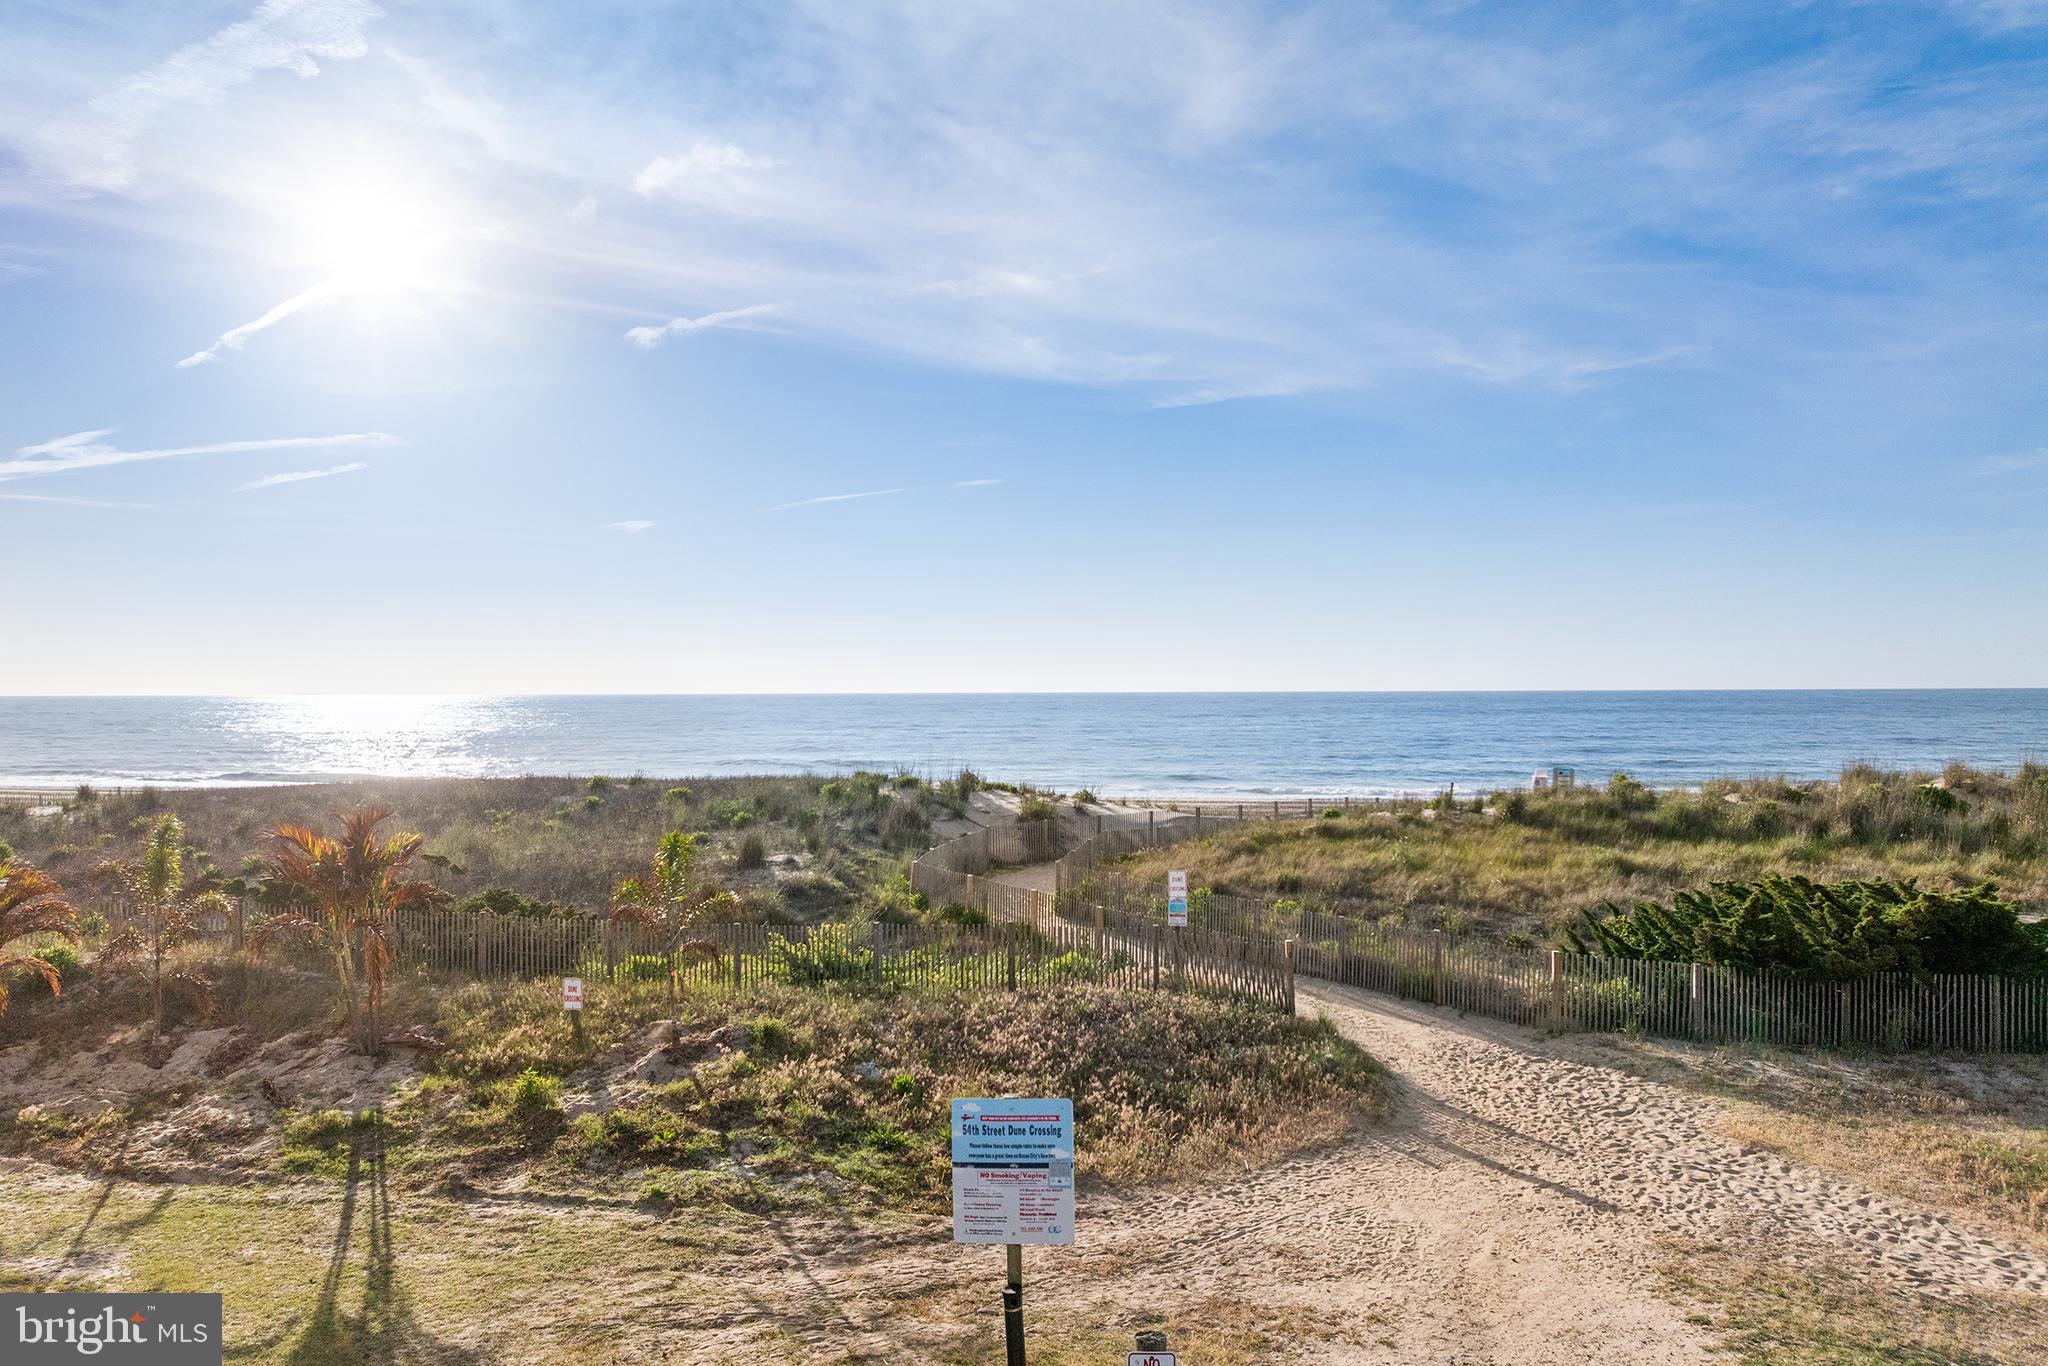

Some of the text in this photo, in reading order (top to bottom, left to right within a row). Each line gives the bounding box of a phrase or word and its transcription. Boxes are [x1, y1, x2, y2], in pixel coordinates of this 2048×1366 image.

[962, 1124, 1062, 1138] 54th Street Dune Crossing
